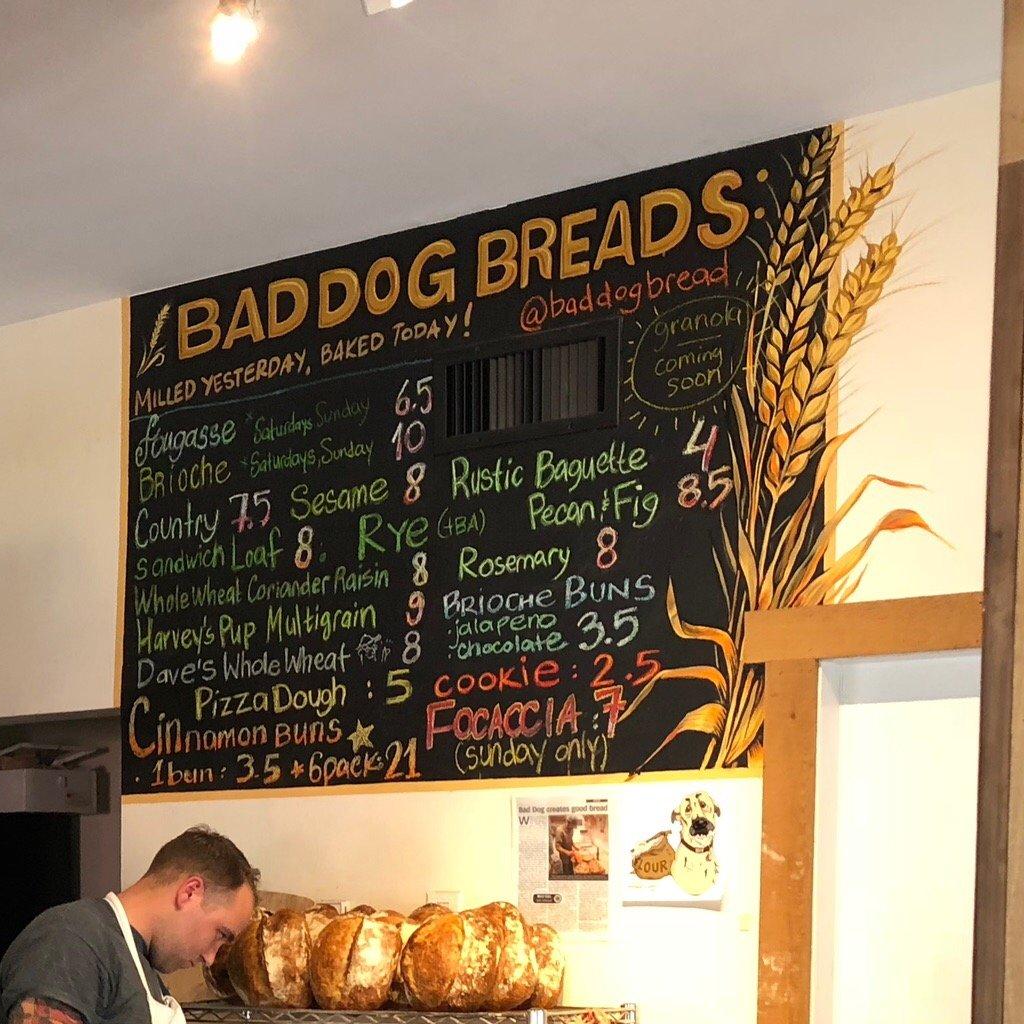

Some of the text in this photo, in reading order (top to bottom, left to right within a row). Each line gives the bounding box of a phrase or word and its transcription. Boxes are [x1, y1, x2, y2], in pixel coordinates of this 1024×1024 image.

[178, 168, 769, 360] BAD DOG BREADS:
[520, 250, 730, 332] @baddogbread
[654, 301, 742, 350] granola
[134, 377, 196, 416] MILLED
[201, 348, 311, 396] YESTERDAY,
[321, 331, 385, 366] BAKED
[655, 345, 723, 377] coming
[667, 367, 721, 398] soon
[253, 411, 313, 444] Saturdays
[394, 376, 433, 416] 6.5
[319, 437, 374, 466] Sunday
[391, 420, 426, 461] 10
[451, 418, 719, 500] Rustic Baguette 4
[290, 462, 426, 521] Sesame 8
[528, 492, 595, 530] Pecan
[613, 479, 659, 529] Fig
[677, 465, 734, 509] 8.5
[134, 499, 219, 548] Country
[231, 526, 284, 571] Loaf
[294, 525, 314, 570] 8
[247, 572, 329, 604] Coriander
[334, 563, 389, 592] Raisin
[411, 551, 429, 587] 8
[457, 526, 619, 581] Rosemary 8
[564, 574, 656, 609] BUNS
[136, 590, 426, 655] Harvey's Pup Multigrain 9
[449, 606, 639, 651] jalapeno 3.5
[457, 631, 569, 660] chocolate
[223, 650, 281, 682] Whole
[284, 642, 351, 675] Wheat
[402, 630, 421, 665] 8
[590, 650, 662, 688] 2.5
[195, 685, 269, 721] Pizza
[386, 668, 413, 705] 5
[593, 684, 627, 739] 7
[128, 695, 268, 759] Cinnamon
[555, 730, 608, 774] only)
[236, 753, 282, 785] 3.5
[384, 737, 421, 780] 21
[571, 804, 588, 814] good
[589, 804, 608, 812] bread
